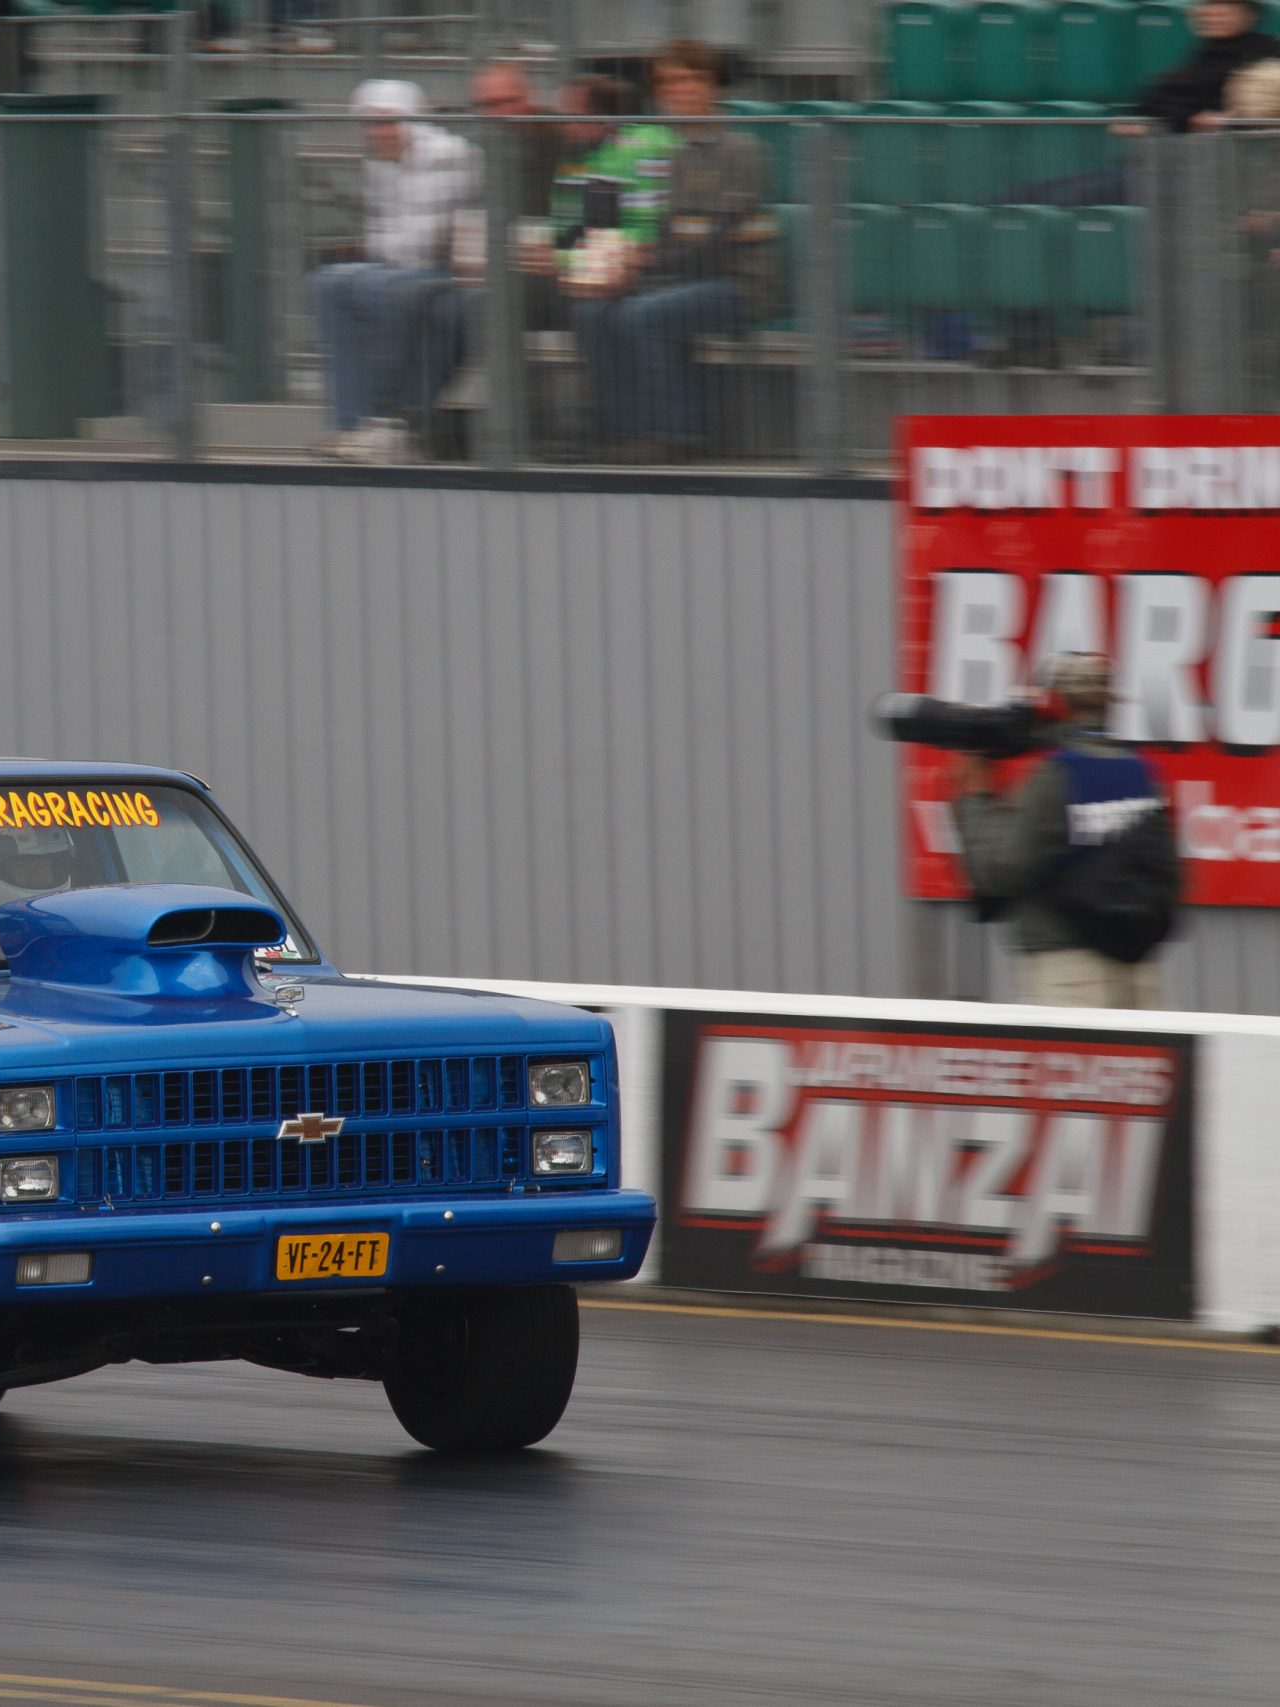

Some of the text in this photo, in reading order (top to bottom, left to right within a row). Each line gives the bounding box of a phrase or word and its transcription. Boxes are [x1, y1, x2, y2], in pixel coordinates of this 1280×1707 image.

[914, 446, 1120, 508] DON'T
[789, 1041, 1166, 1106] JAPANESE CARS
[690, 1036, 1164, 1268] BANZAI
[288, 1240, 380, 1274] VF-24-FT
[803, 1243, 1014, 1291] MAGAZINE
